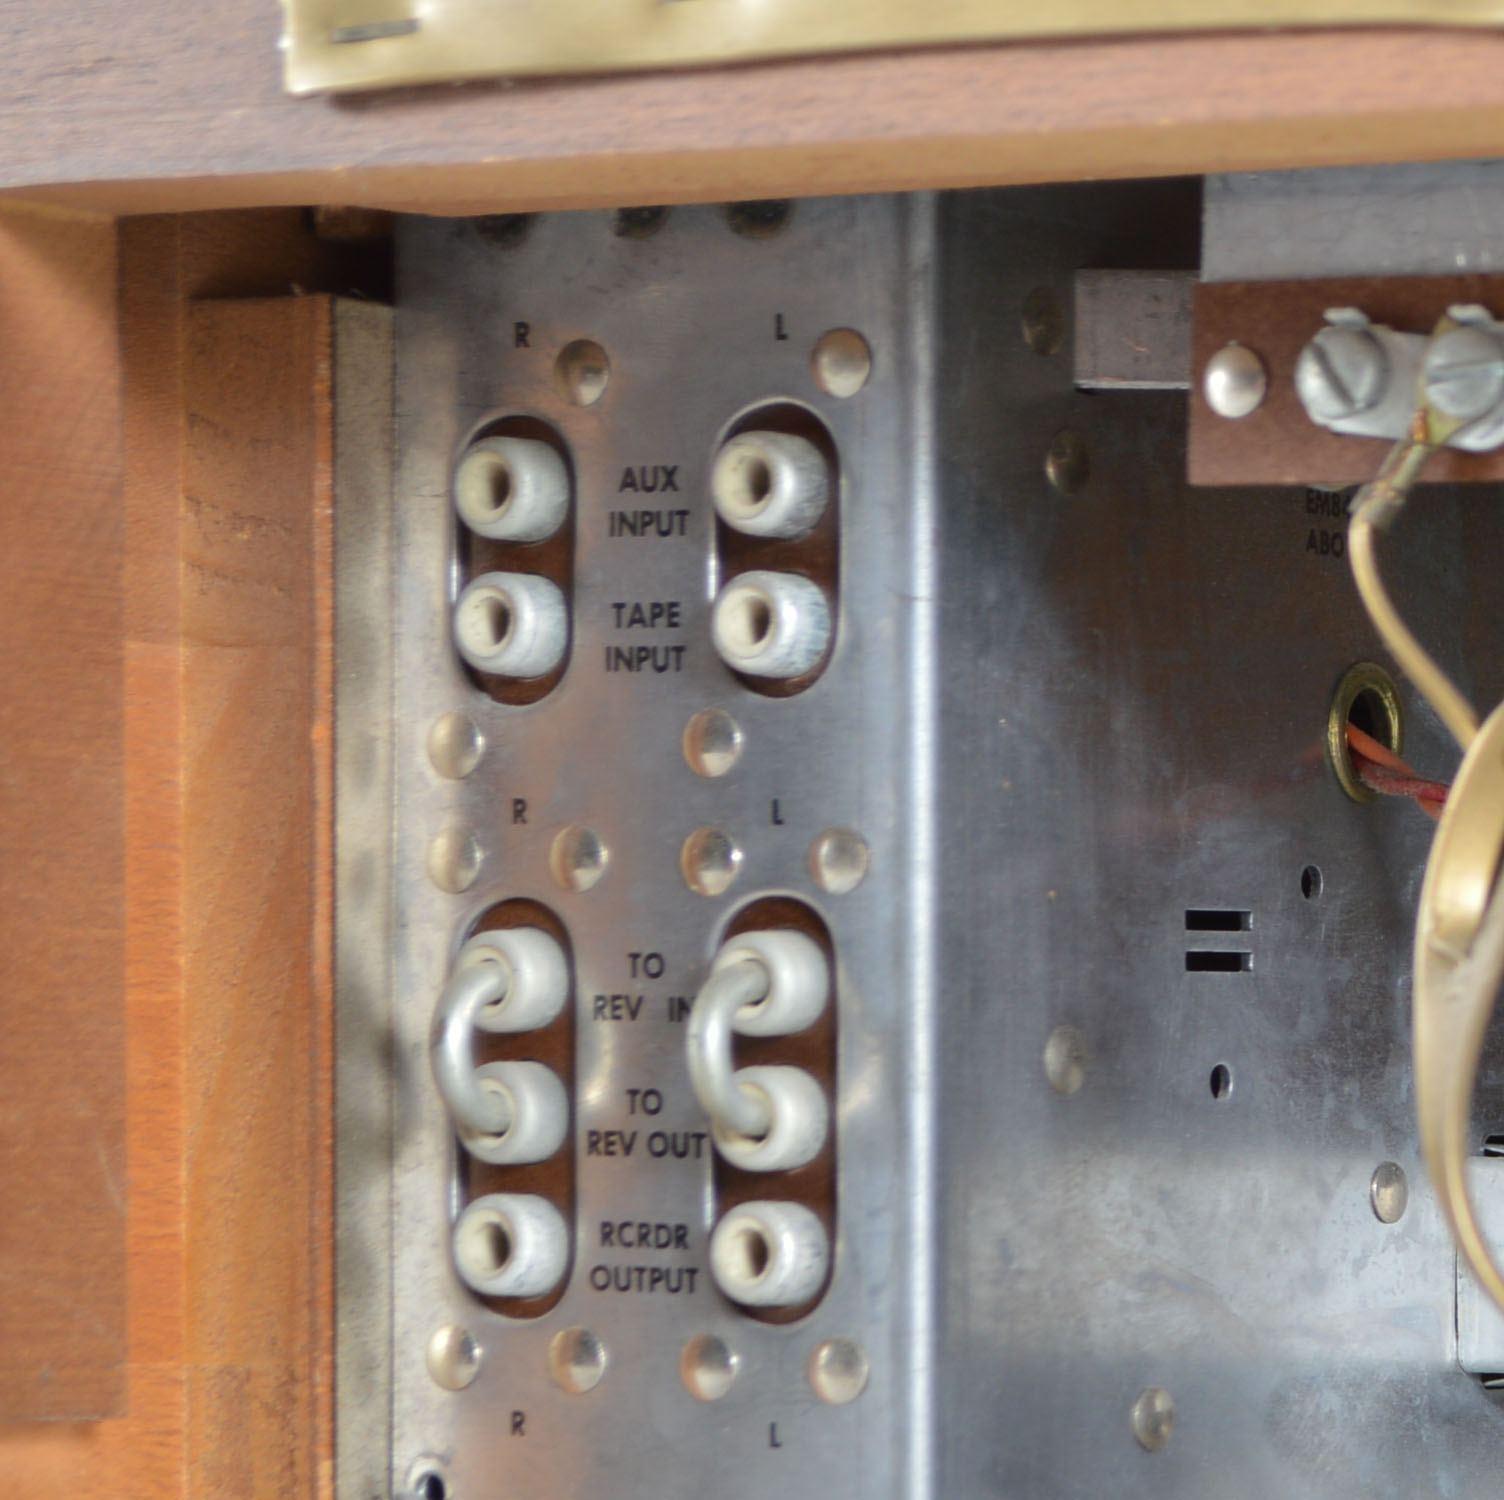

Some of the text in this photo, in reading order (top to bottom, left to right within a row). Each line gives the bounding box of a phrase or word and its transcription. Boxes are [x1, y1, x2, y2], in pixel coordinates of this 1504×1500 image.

[513, 321, 531, 349] R
[775, 314, 789, 342] L
[617, 465, 680, 493] AUX
[609, 509, 691, 538] INPUT
[611, 602, 681, 629] TAPE
[605, 645, 687, 673] INPUT
[512, 799, 528, 825] R
[772, 800, 784, 826] L
[628, 952, 666, 979] TO
[592, 994, 643, 1022] REV
[626, 1088, 663, 1116] TO
[587, 1130, 707, 1159] REV OUT
[600, 1222, 690, 1251] RCRDR
[589, 1264, 699, 1294] OUTPUT
[511, 1410, 526, 1437] R
[769, 1422, 783, 1449] L
